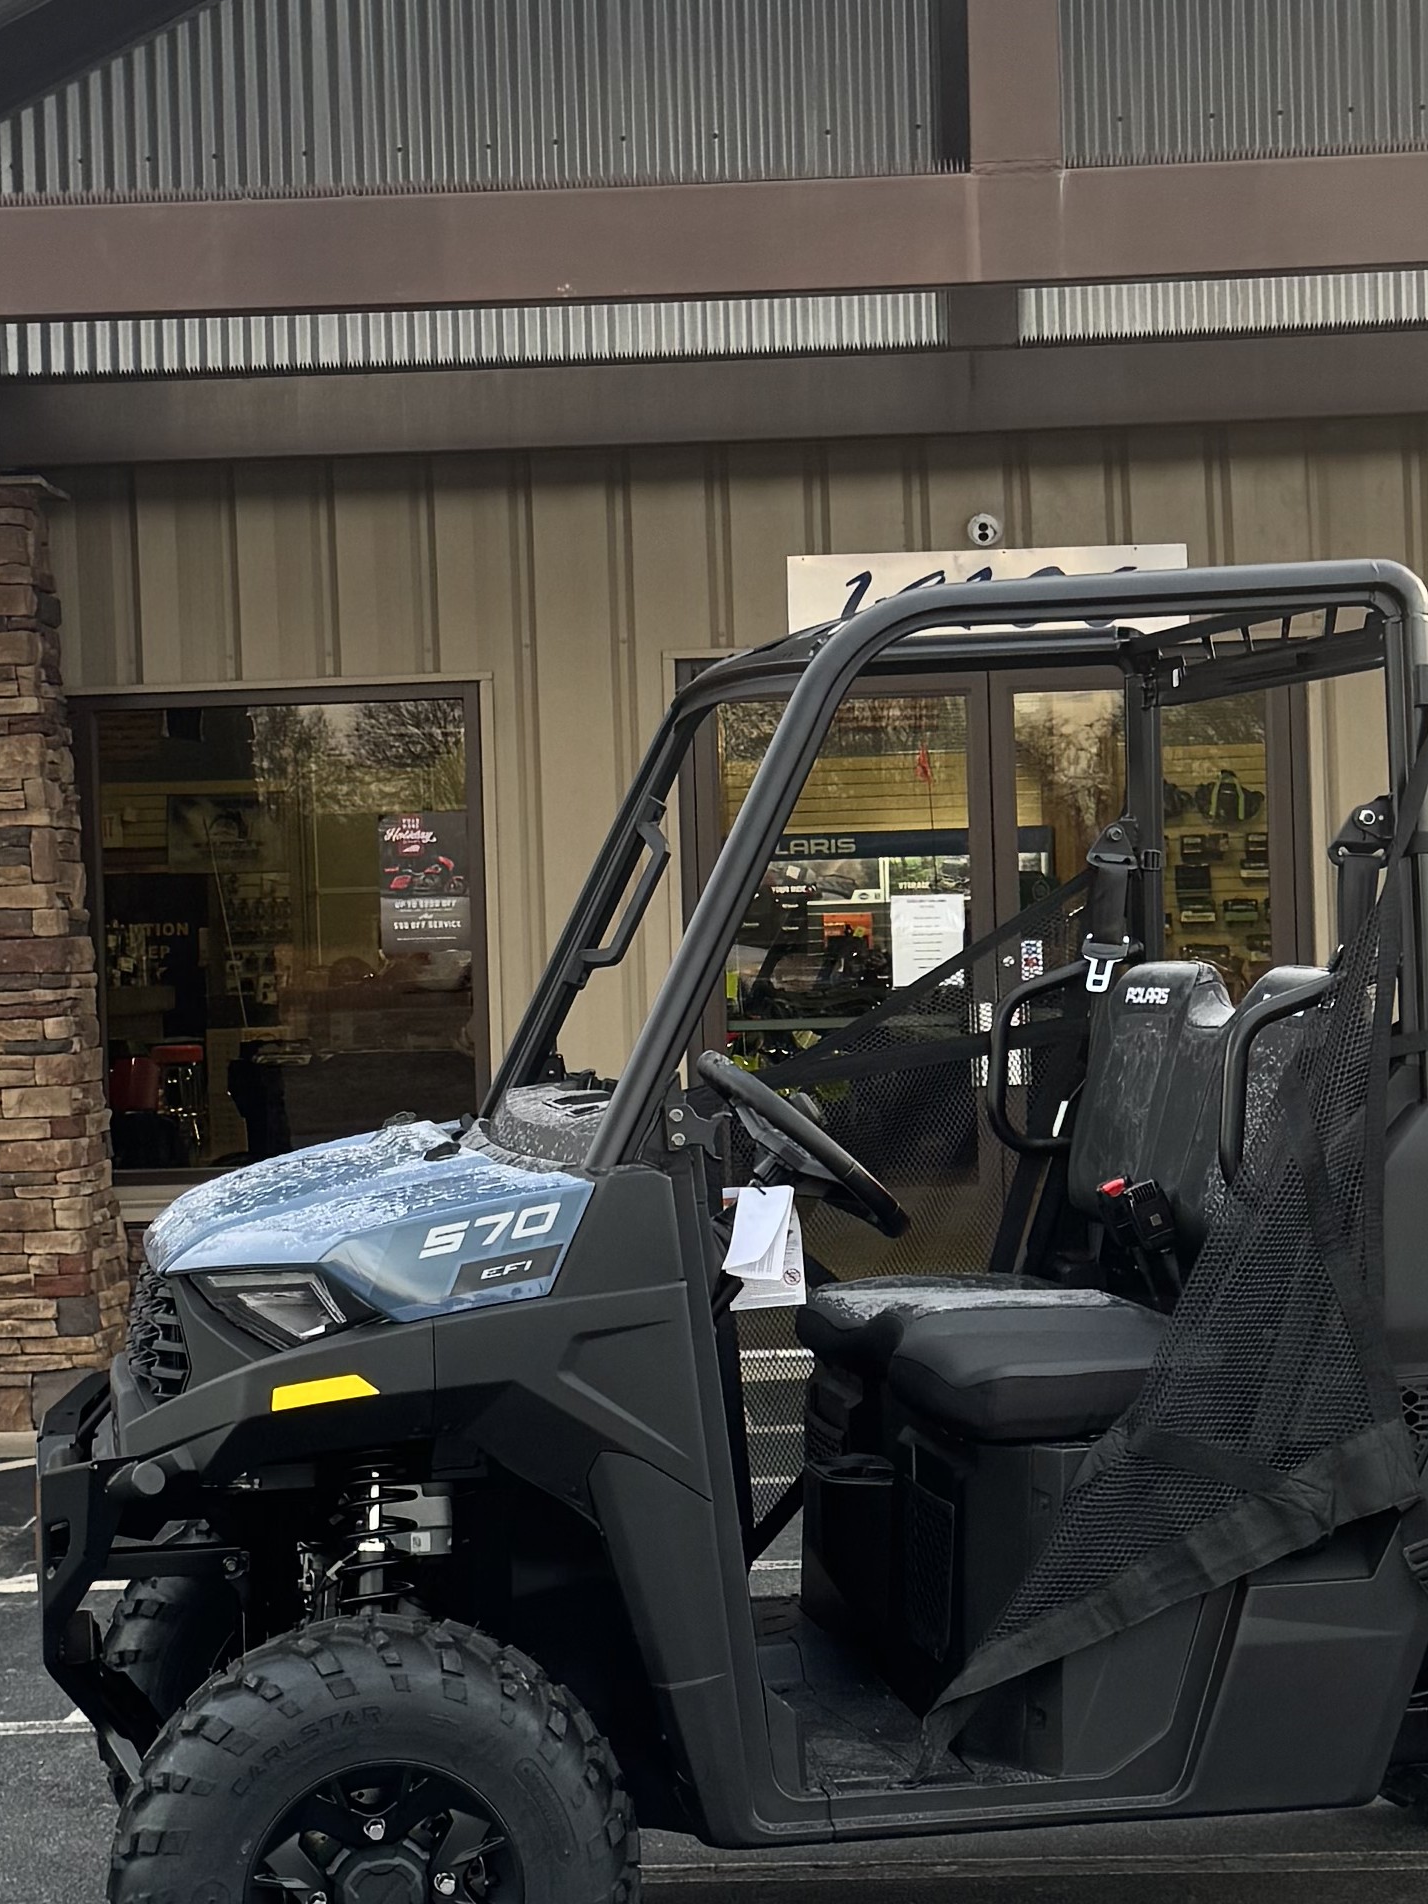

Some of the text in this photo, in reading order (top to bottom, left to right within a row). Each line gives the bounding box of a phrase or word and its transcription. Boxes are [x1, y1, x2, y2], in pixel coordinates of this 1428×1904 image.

[774, 837, 857, 856] LARIS
[1124, 986, 1170, 1005] POLARIS
[418, 1202, 561, 1260] 570
[480, 1259, 533, 1280] EFI
